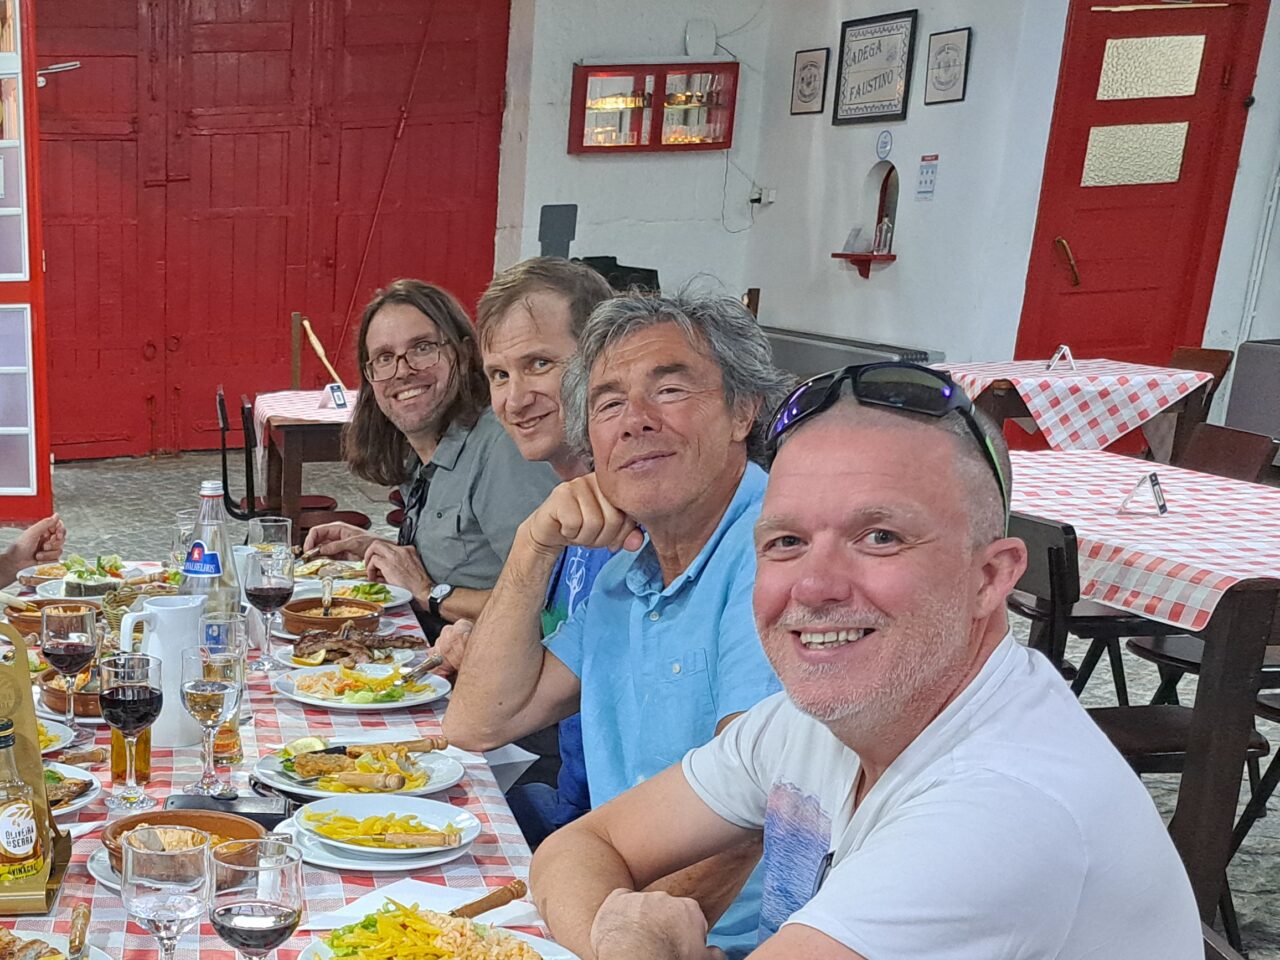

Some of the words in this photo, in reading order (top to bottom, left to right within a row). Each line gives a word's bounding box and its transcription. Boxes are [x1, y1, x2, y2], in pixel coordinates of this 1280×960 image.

[850, 39, 883, 66] ADEGA
[849, 69, 894, 101] FAUSTINO
[5, 825, 34, 840] OLIVEIRA
[12, 836, 34, 849] SERRA
[10, 864, 38, 876] VINAGRE
